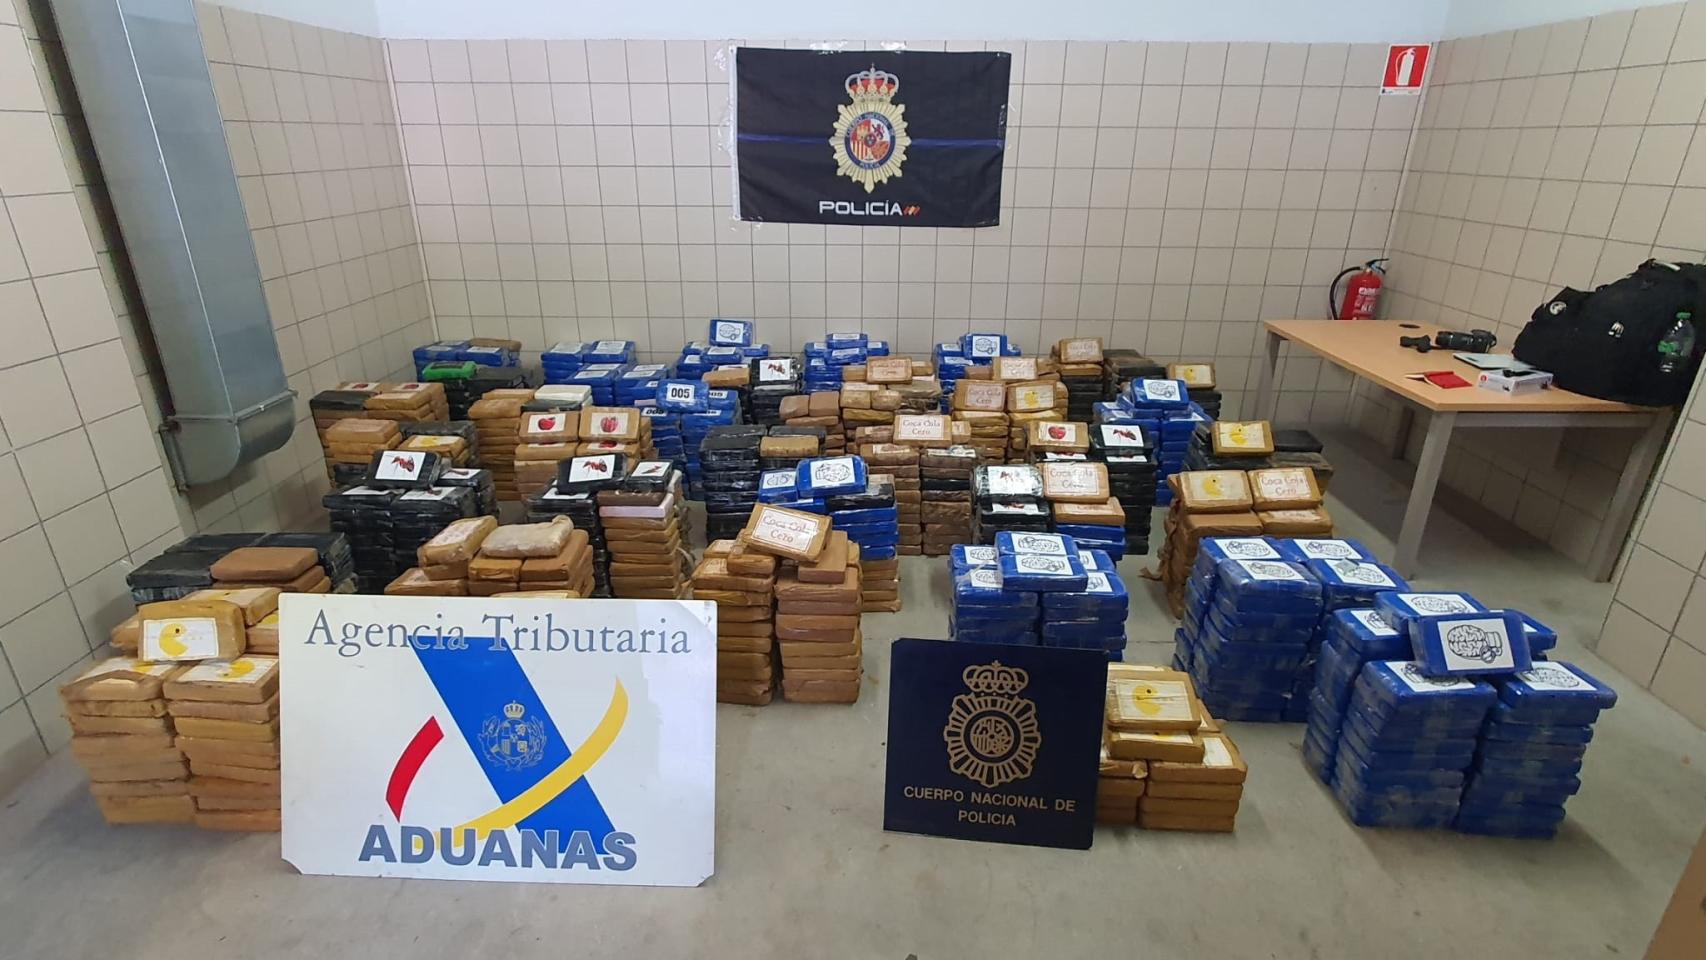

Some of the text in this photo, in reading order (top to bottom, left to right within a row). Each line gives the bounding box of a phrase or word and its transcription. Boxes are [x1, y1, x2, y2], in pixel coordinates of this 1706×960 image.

[819, 200, 903, 216] POLICÍA
[670, 387, 691, 399] 005
[1049, 467, 1072, 477] Coca
[770, 529, 794, 543] Cero
[304, 609, 691, 657] Agencia Tributaria
[903, 785, 1076, 812] CUERPO NACIONAL DE
[958, 809, 1016, 827] POLICIA
[358, 823, 638, 872] ADUANAS
